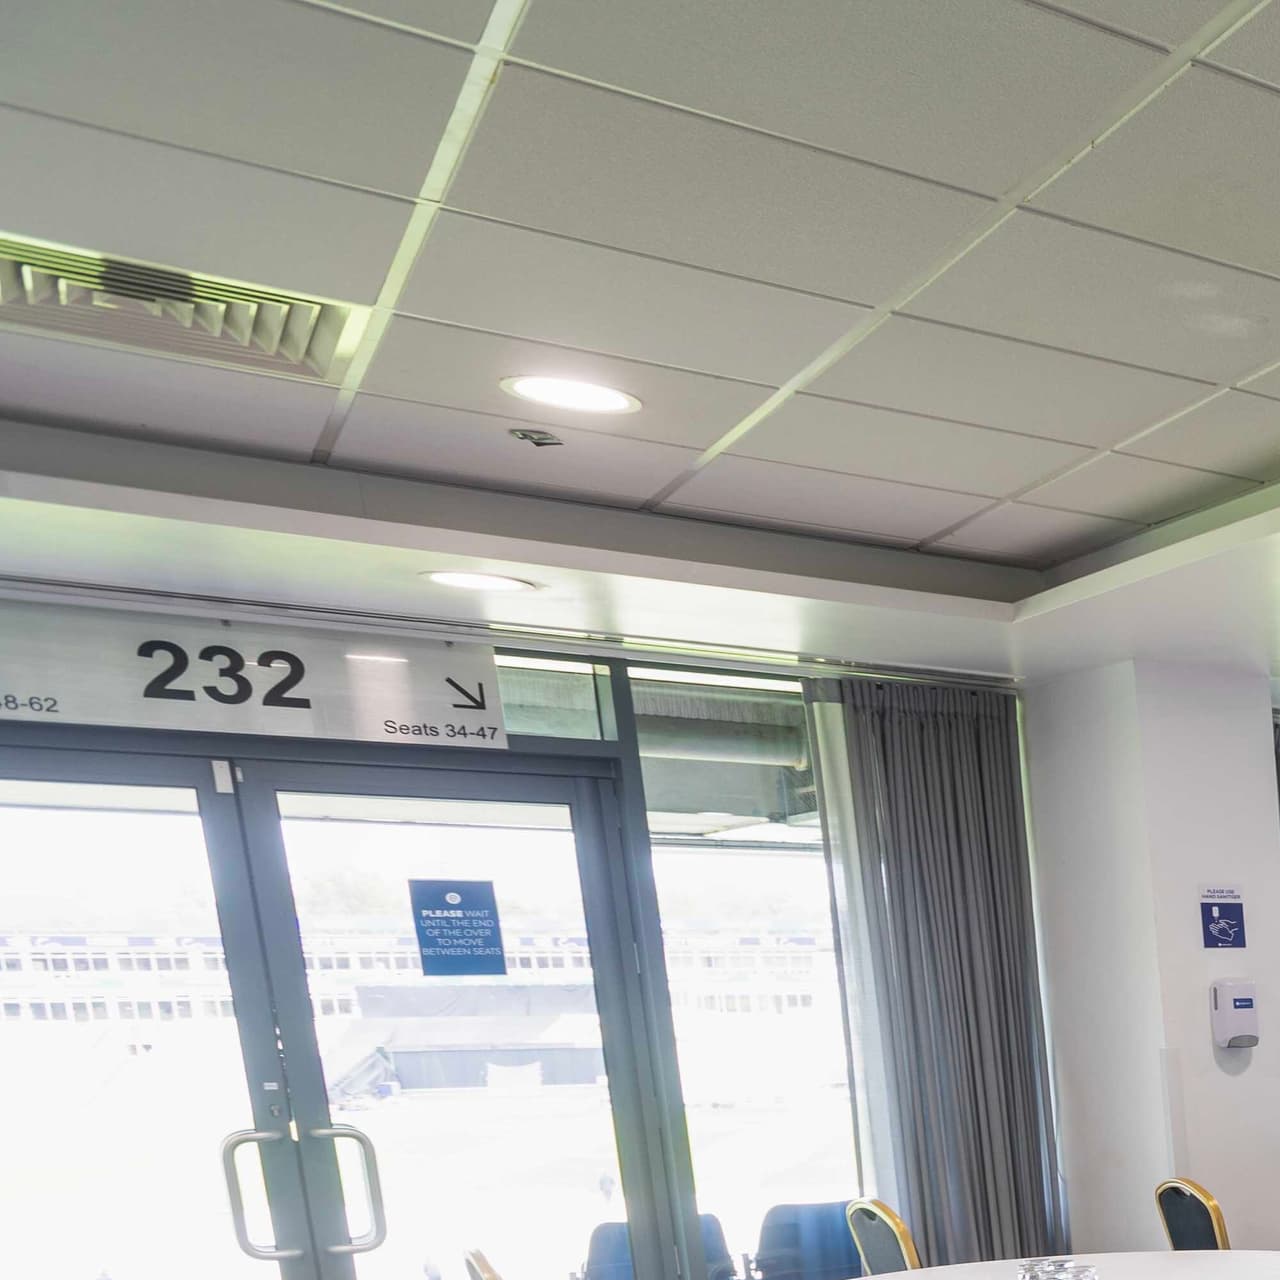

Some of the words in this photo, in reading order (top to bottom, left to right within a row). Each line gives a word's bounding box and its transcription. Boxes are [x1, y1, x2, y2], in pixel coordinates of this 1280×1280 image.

[136, 640, 312, 709] 232
[0, 695, 60, 713] 8-62
[384, 720, 440, 737] Seats
[445, 724, 498, 740] 34-47
[421, 910, 464, 918] PLEASE
[464, 910, 490, 918] WAIT
[420, 919, 450, 928] UNTIL
[451, 919, 471, 927] THE
[472, 919, 494, 927] END
[425, 928, 441, 937] OF
[442, 928, 463, 937] THE
[463, 928, 492, 937] OVER
[436, 938, 451, 946] TO
[453, 938, 485, 946] MOVE
[422, 947, 472, 956] BETWEEN
[472, 947, 502, 956] SEATS
